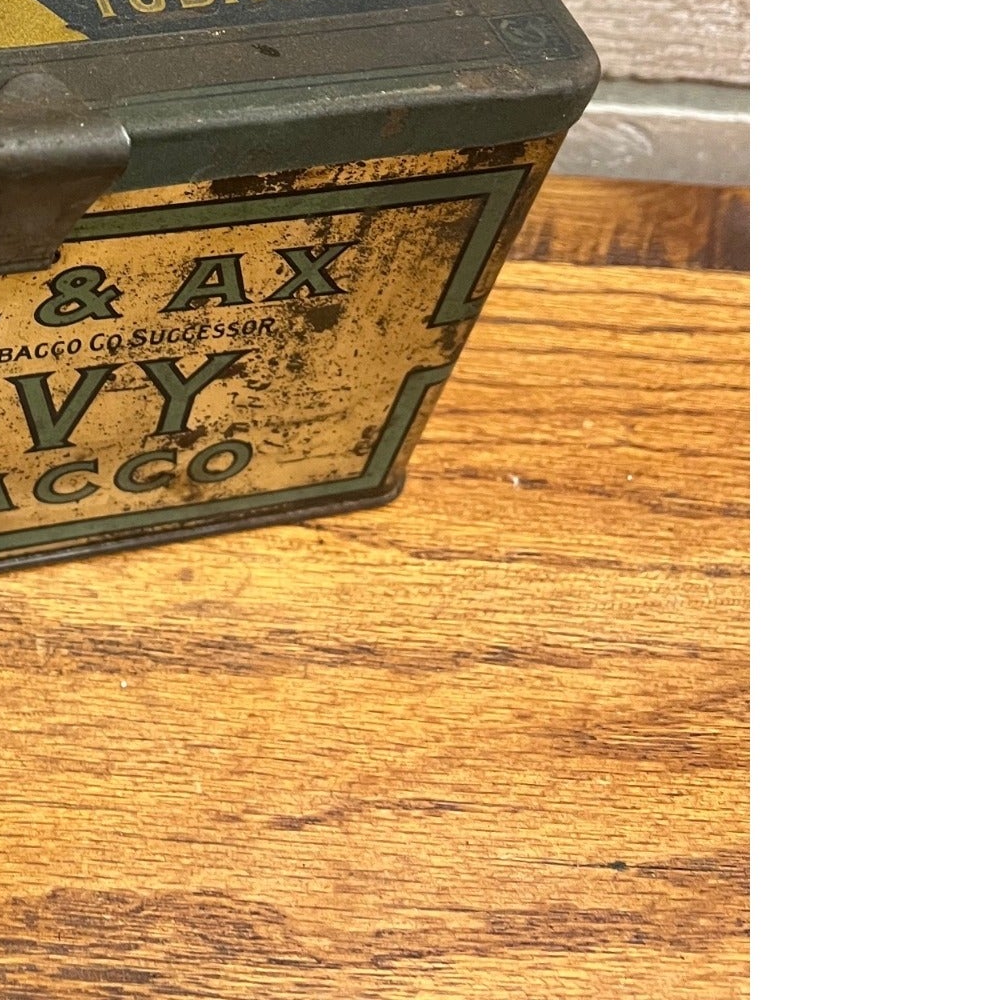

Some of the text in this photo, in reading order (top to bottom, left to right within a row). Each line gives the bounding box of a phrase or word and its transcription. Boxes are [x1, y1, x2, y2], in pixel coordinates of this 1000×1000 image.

[33, 264, 124, 328] &
[158, 240, 361, 313] AX
[130, 317, 276, 349] SUCCESSOR
